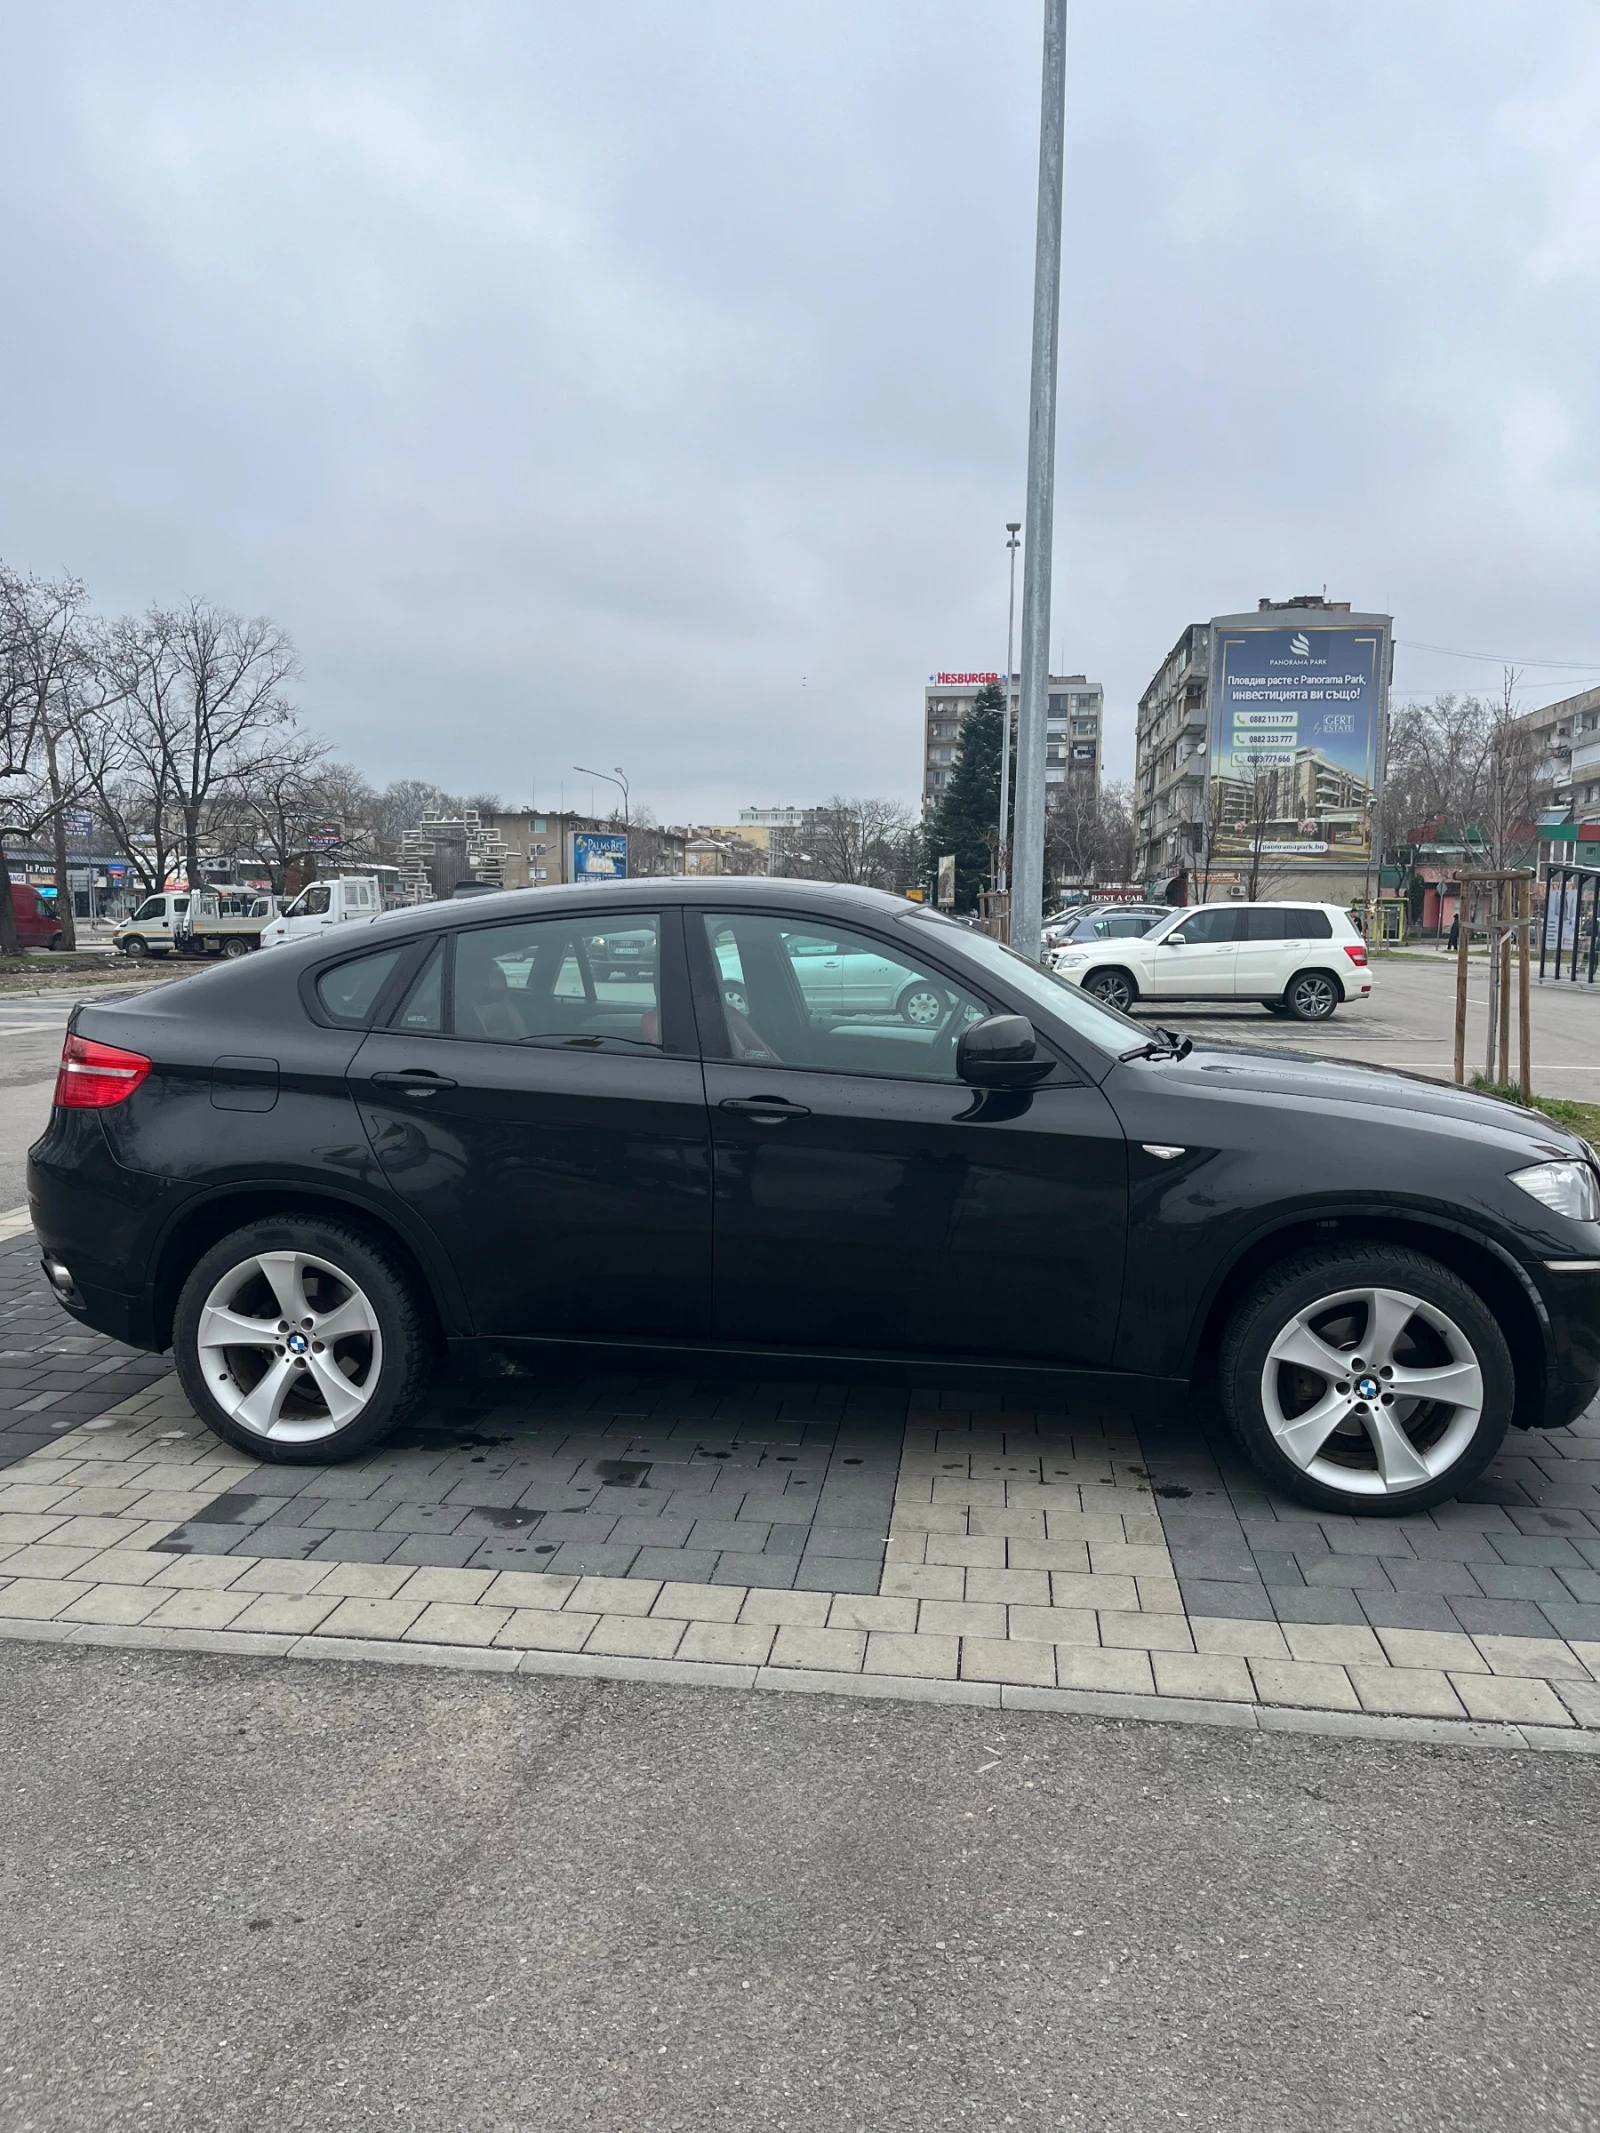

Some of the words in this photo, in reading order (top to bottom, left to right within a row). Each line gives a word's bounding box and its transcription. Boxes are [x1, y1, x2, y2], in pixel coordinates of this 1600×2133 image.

[937, 672, 998, 684] HESBURGER
[1227, 675, 1266, 687] Пловдив
[1267, 677, 1292, 687] расте
[1300, 674, 1343, 685] Panorama
[1344, 673, 1367, 685] Park,
[1232, 690, 1308, 701] инвестицията
[1310, 690, 1324, 700] ви
[1325, 688, 1360, 701] също!
[1249, 715, 1266, 723] 0882
[1267, 715, 1279, 723] 111
[1280, 715, 1293, 723] 777
[1325, 715, 1353, 725] GERT
[1248, 735, 1265, 743] 0882
[1266, 735, 1279, 743] 333
[1280, 735, 1293, 743] 777
[588, 839, 610, 850] PALMS
[611, 840, 623, 851] BET
[1091, 894, 1116, 902] RENT
[1116, 894, 1123, 902] A
